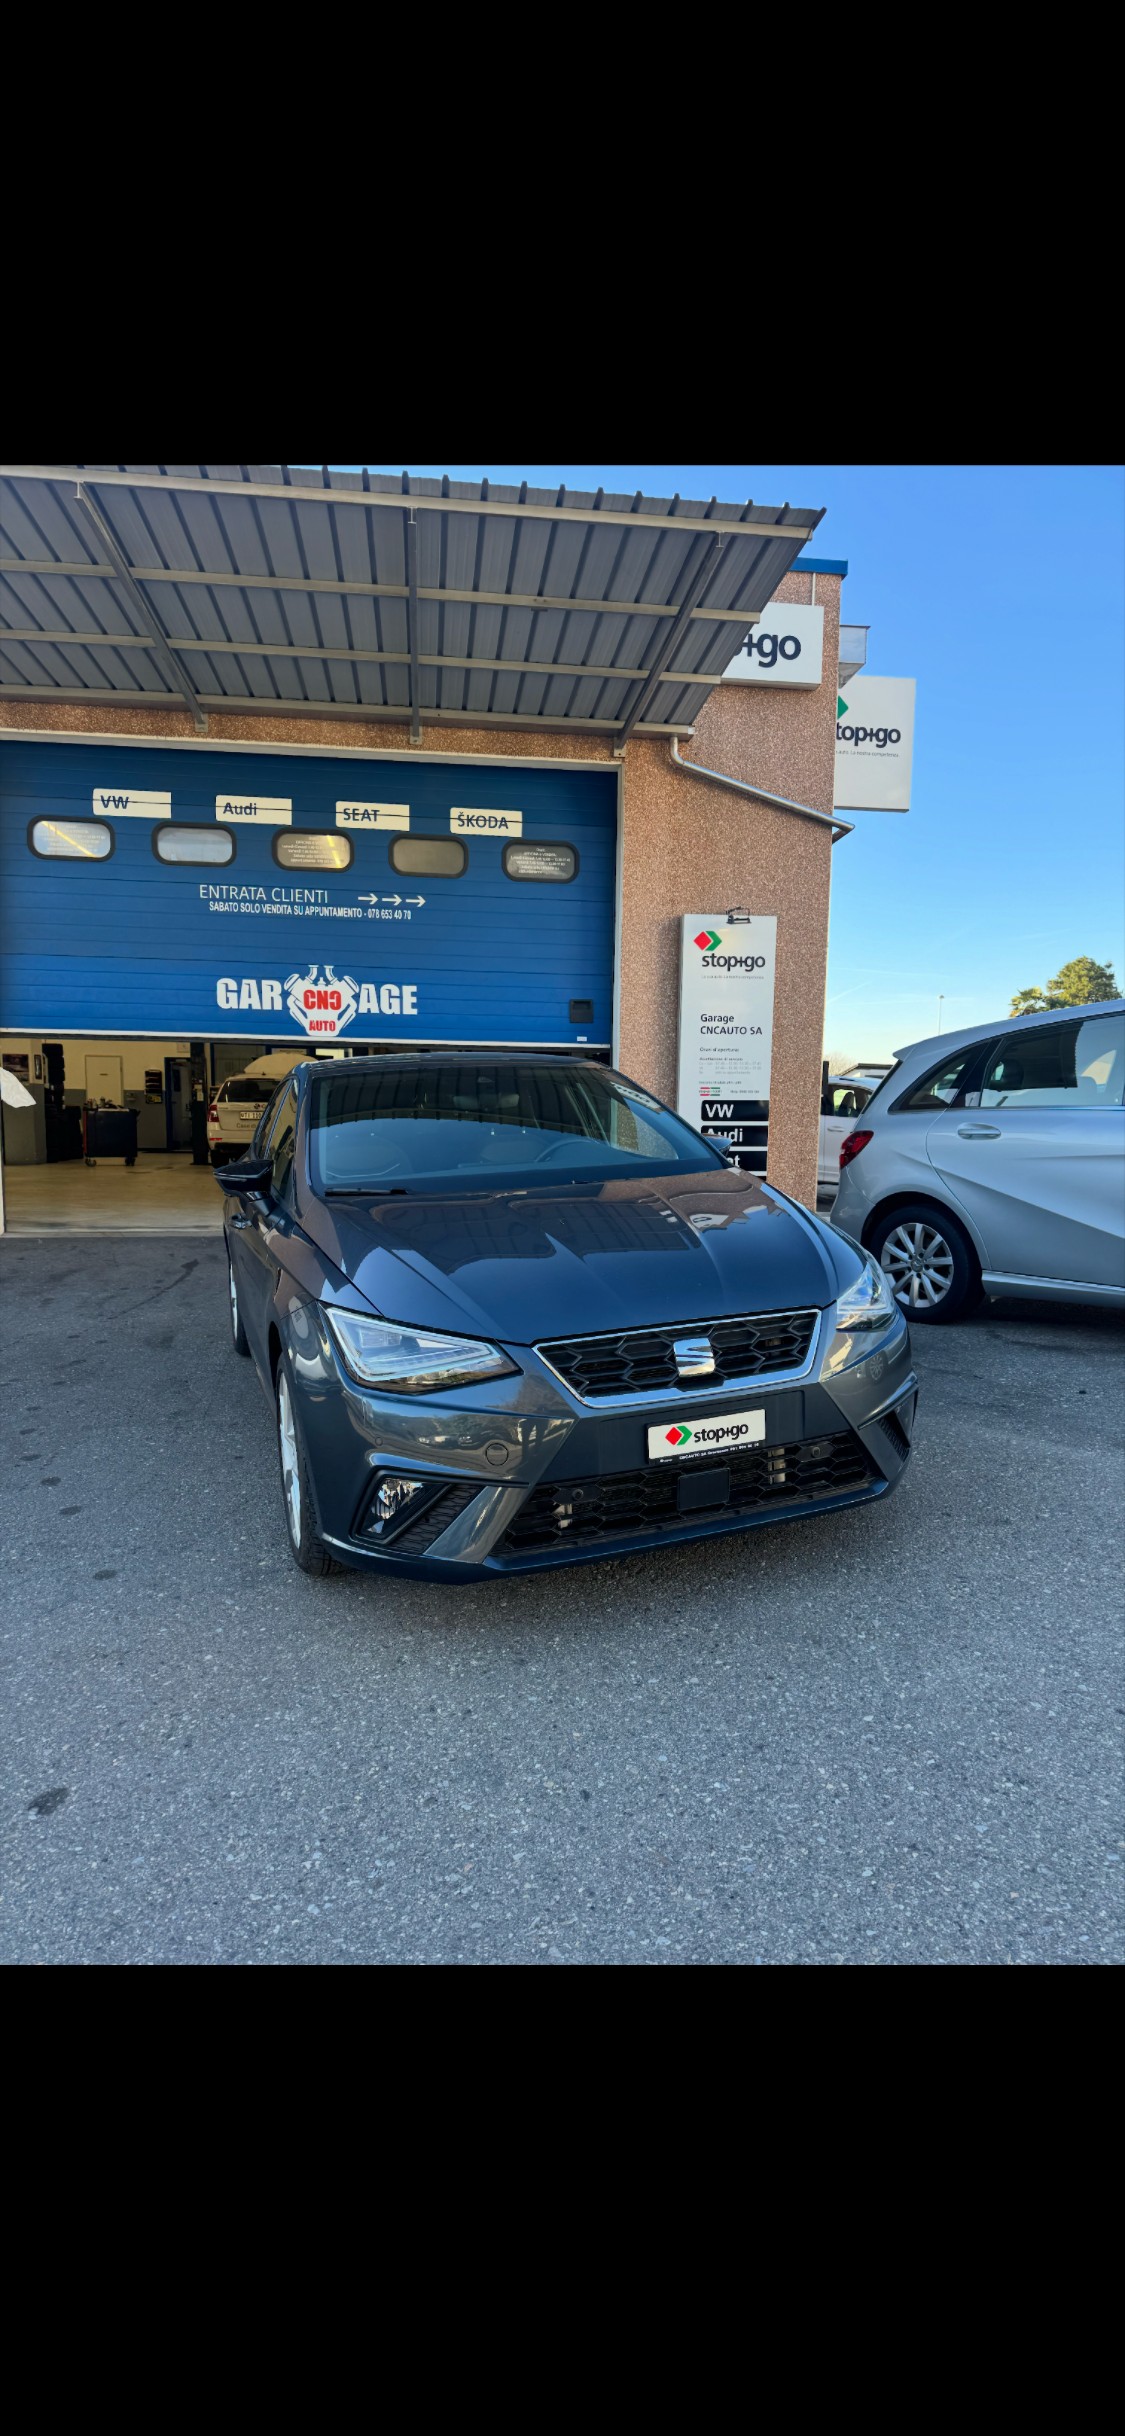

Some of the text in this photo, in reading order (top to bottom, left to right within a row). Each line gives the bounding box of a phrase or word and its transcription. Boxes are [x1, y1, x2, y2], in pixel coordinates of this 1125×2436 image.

[733, 632, 802, 669] +go
[100, 795, 129, 810] VW
[222, 802, 257, 816] Audi
[343, 807, 380, 822] SEAT
[457, 812, 509, 829] ŠKODA
[199, 884, 328, 903] ENTRATA CLIENTI
[209, 901, 239, 912] SABATO
[240, 902, 261, 914] SOLO
[261, 903, 293, 915] VENDITA
[293, 905, 304, 915] SU
[304, 905, 362, 918] APPUNTAMENTO
[367, 908, 380, 919] 078
[381, 909, 393, 919] 653
[394, 909, 402, 920] 40
[701, 952, 766, 972] stop+go
[308, 1019, 336, 1032] AUTO
[700, 1013, 735, 1025] Garage
[700, 1025, 763, 1035] CNCAUTO SA
[705, 1103, 734, 1118] VW
[693, 1424, 749, 1443] stop+go
